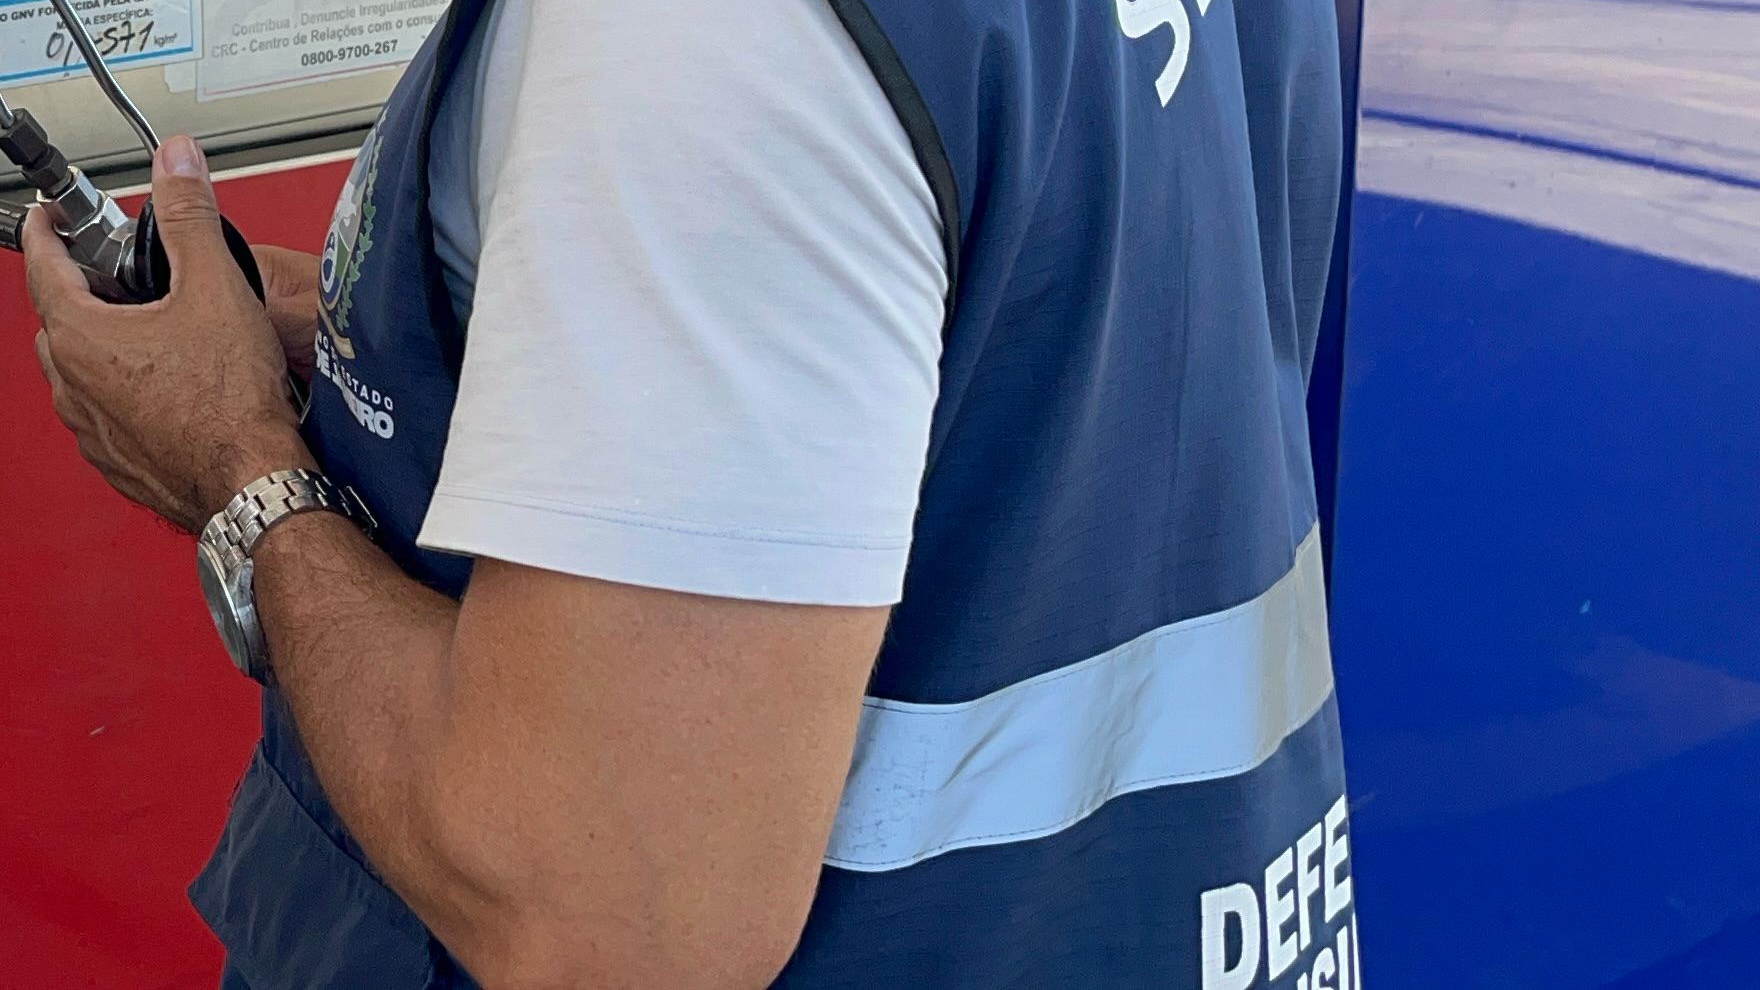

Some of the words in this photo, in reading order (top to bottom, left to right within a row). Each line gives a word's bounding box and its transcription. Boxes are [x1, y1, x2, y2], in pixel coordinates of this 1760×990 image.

[11, 9, 35, 21] GNV
[231, 17, 291, 37] Contribua
[249, 36, 291, 53] Centro
[293, 32, 308, 46] de
[310, 23, 364, 43] Relações
[367, 21, 393, 34] com
[395, 20, 404, 30] o
[300, 38, 399, 67] 0800-9700-267
[1201, 794, 1351, 990] DEFE
